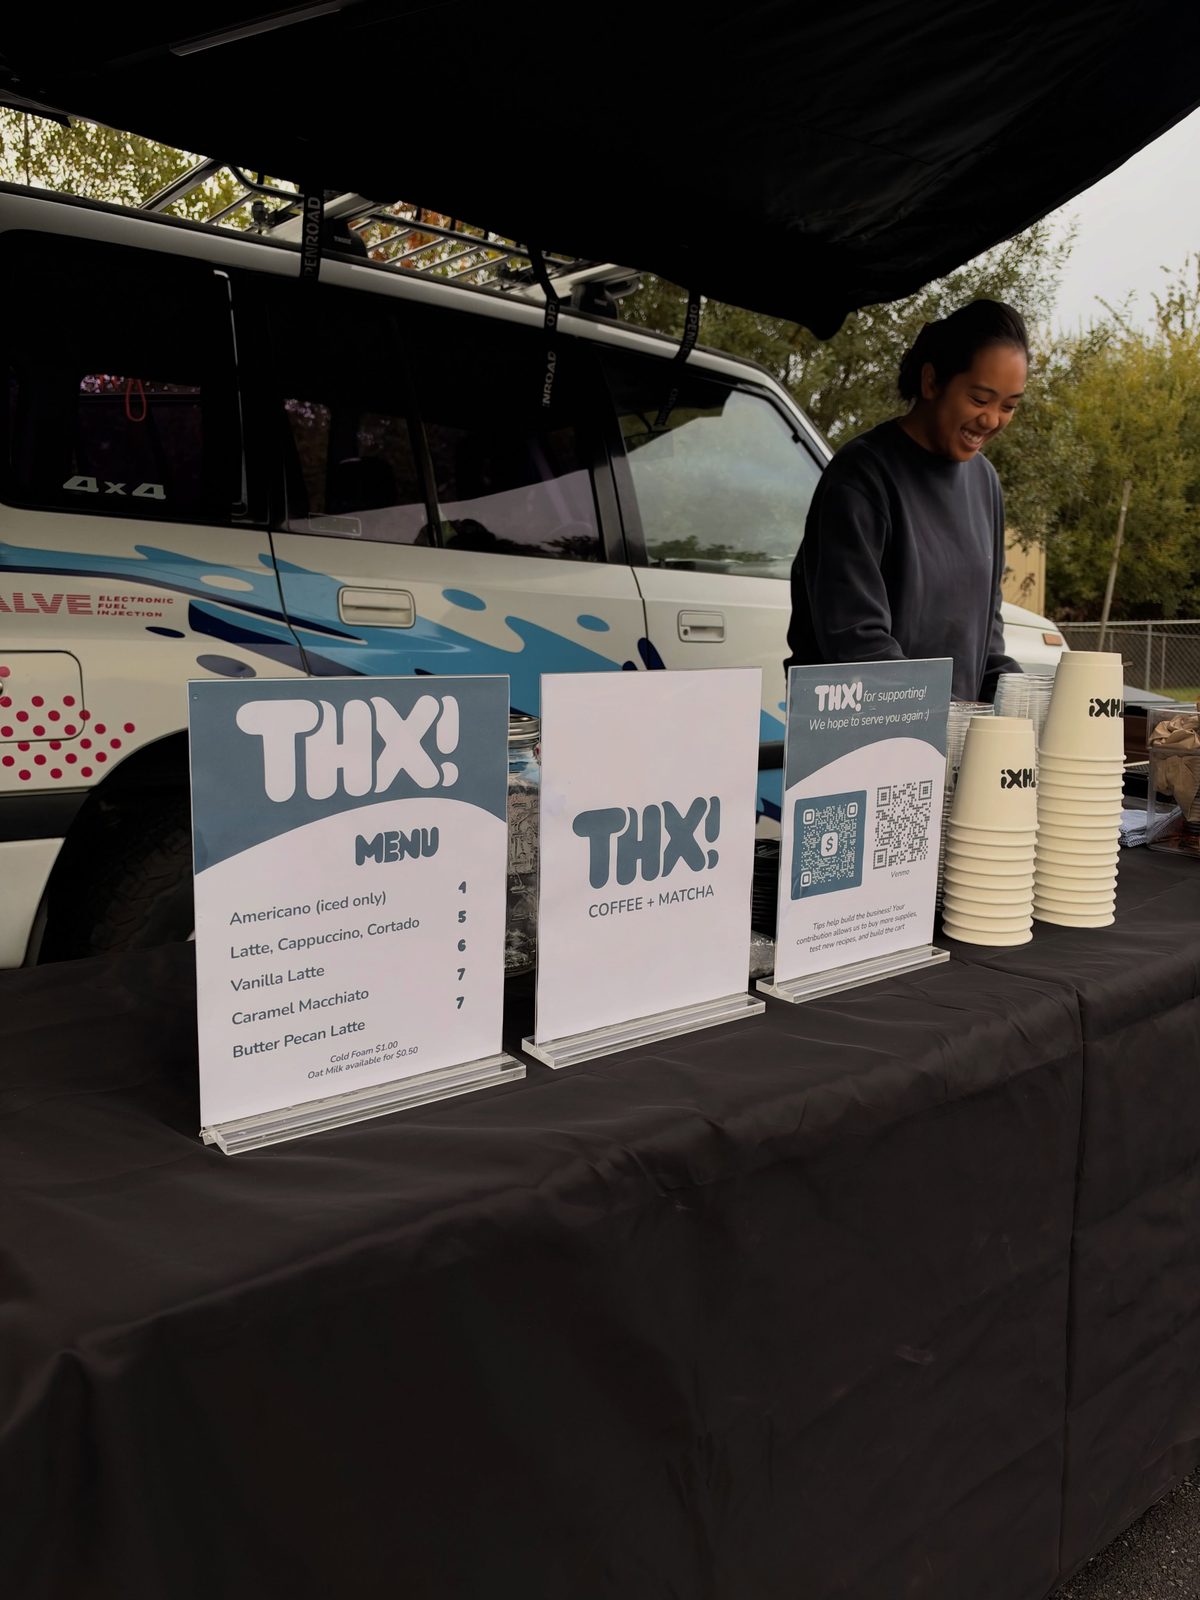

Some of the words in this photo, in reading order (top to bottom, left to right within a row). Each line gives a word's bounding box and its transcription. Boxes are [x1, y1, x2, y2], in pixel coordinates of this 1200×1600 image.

[99, 595, 174, 604] ELECTRONIC
[814, 681, 863, 712] THX!
[863, 690, 877, 702] for
[878, 685, 928, 703] supporting!
[809, 718, 825, 731] We
[827, 717, 849, 730] hope
[850, 716, 860, 727] to
[861, 714, 884, 726] serve
[885, 713, 901, 725] you
[901, 711, 924, 724] again
[236, 695, 459, 803] THX!
[355, 827, 439, 866] MENU
[572, 795, 720, 889] THX!
[890, 870, 910, 878] Venmo
[229, 906, 311, 925] Americano
[316, 896, 349, 915] (iced
[352, 891, 386, 907] only)
[458, 881, 466, 894] 4
[588, 896, 643, 918] COFFEE
[646, 898, 655, 907] +
[658, 884, 715, 906] MATCHA
[813, 922, 825, 931] Tips
[826, 918, 840, 928] help
[841, 915, 855, 924] build
[856, 912, 865, 920] the
[866, 906, 891, 919] business!
[892, 903, 906, 912] Your
[230, 943, 273, 959] Latte,
[277, 929, 363, 951] Cappuccino,
[367, 917, 420, 936] Cortado
[457, 910, 466, 923] 5
[796, 932, 832, 945] contribution
[833, 926, 852, 937] allows
[861, 922, 867, 930] to
[868, 919, 878, 930] buy
[880, 917, 893, 925] more
[894, 911, 917, 922] supplies,
[809, 944, 821, 953] test
[822, 942, 834, 950] new
[836, 936, 857, 947] recipes,
[858, 932, 869, 941] and
[870, 928, 884, 938] build
[885, 926, 893, 934] the
[894, 923, 905, 932] cart
[230, 973, 283, 992] Vanilla
[288, 966, 325, 982] Latte
[457, 939, 466, 952] 6
[232, 1002, 295, 1025] Caramel
[299, 989, 369, 1012] Macchiato
[457, 968, 465, 981] 7
[233, 1040, 280, 1058] Butter
[284, 1030, 326, 1047] Pecan
[330, 1021, 366, 1037] Latte
[456, 996, 465, 1009] 7
[307, 1070, 323, 1079] Oat
[325, 1064, 343, 1076] Milk
[345, 1056, 381, 1070] available
[383, 1052, 394, 1061] for
[396, 1046, 419, 1059] $0.50
[330, 1052, 349, 1063] Cold
[351, 1048, 374, 1059] Foam
[375, 1040, 398, 1054] $1.00
